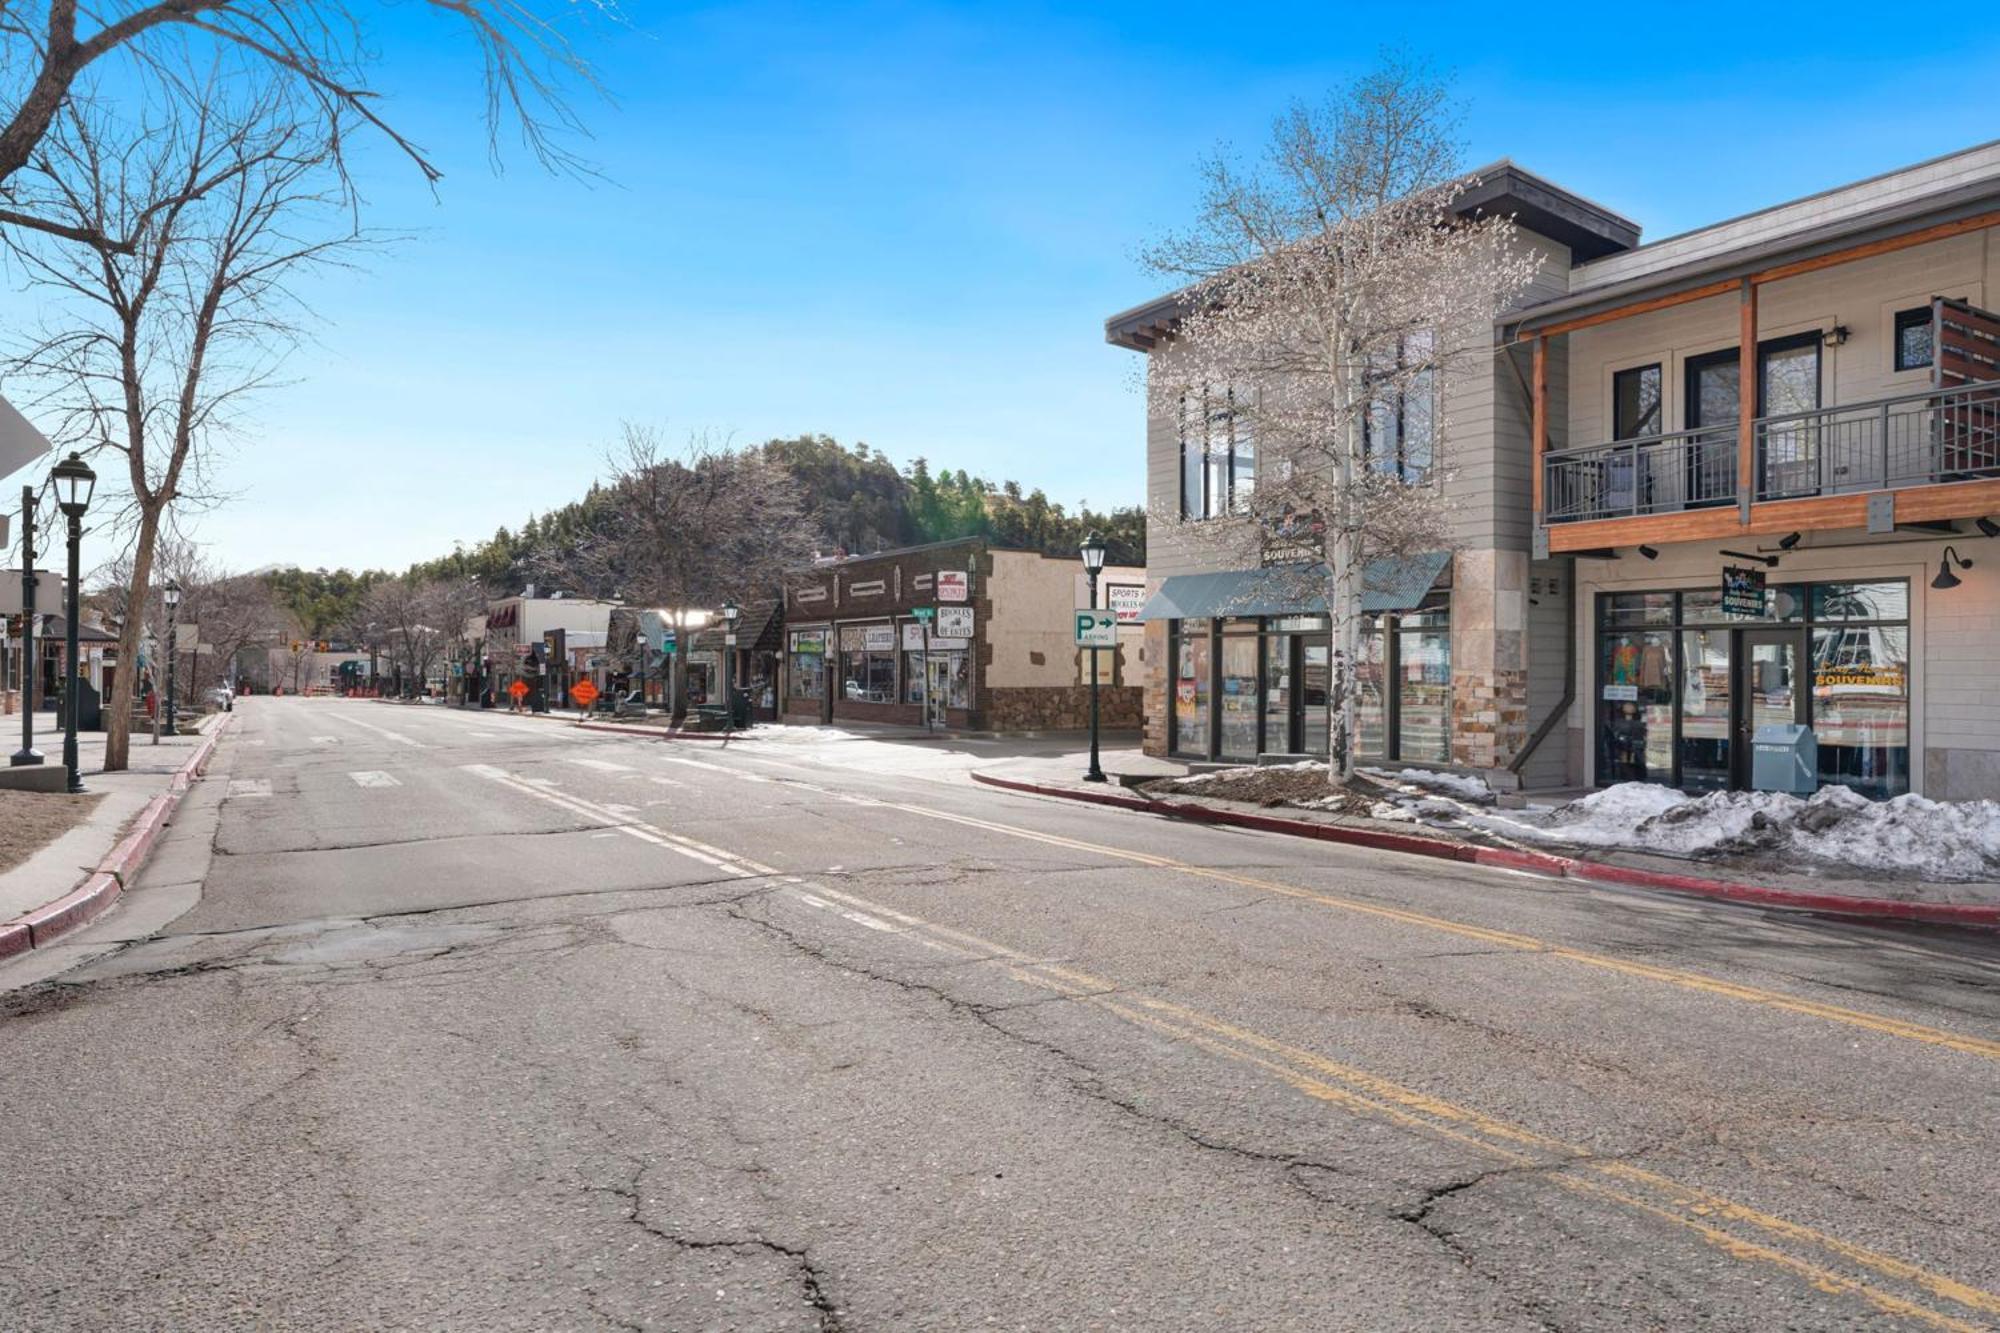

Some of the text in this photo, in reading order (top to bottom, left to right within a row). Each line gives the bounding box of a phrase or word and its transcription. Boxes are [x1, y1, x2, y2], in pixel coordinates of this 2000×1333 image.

[1111, 589, 1140, 598] SPORTS
[1724, 596, 1763, 609] SOUVENIRS
[941, 608, 971, 618] BUCKLES
[1816, 675, 1903, 686] SOUVENIRS
